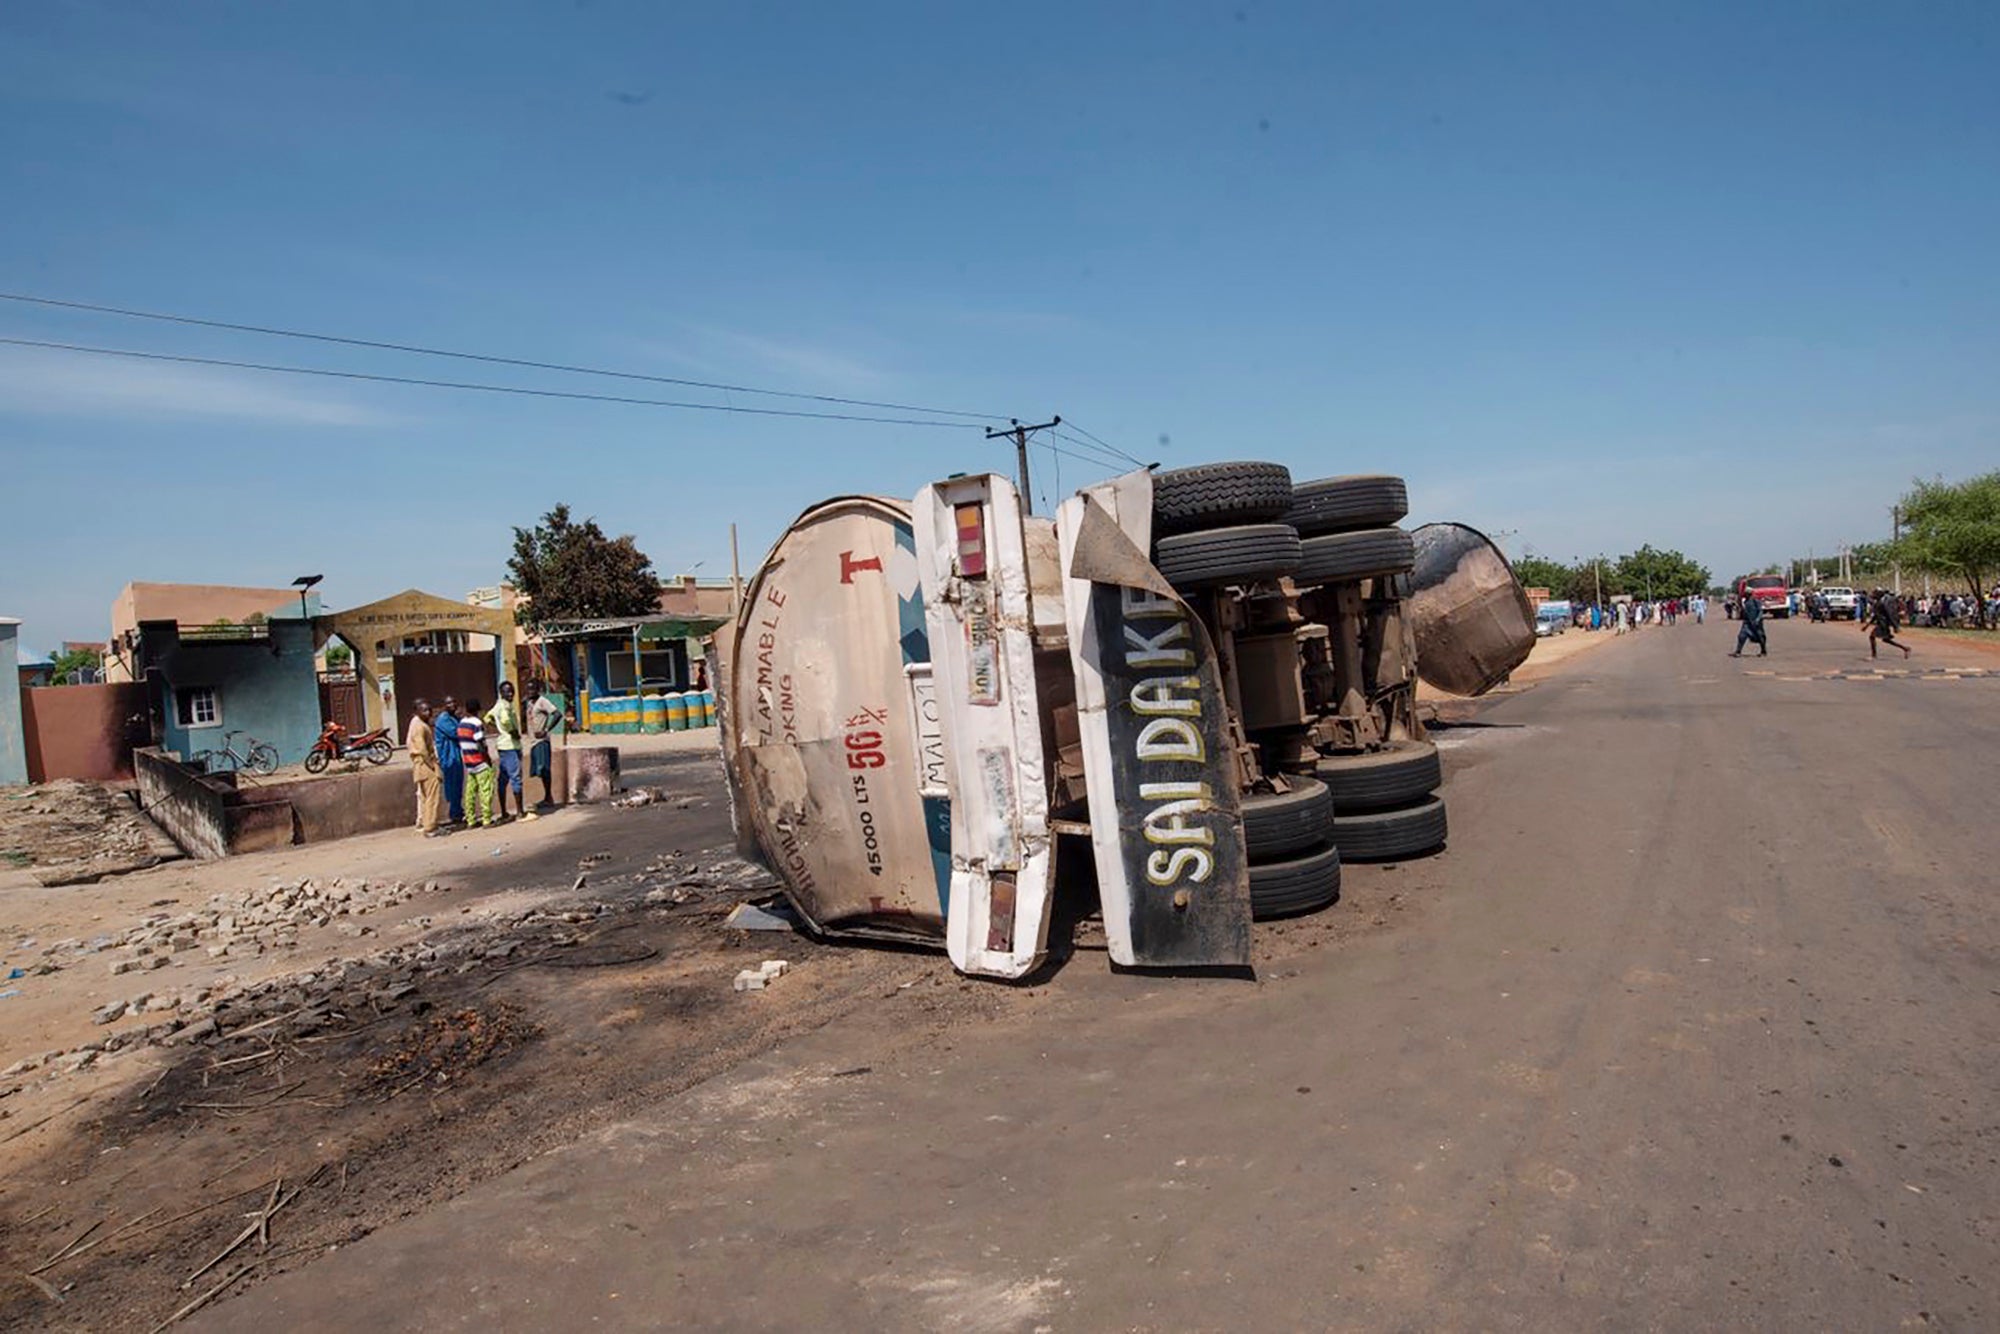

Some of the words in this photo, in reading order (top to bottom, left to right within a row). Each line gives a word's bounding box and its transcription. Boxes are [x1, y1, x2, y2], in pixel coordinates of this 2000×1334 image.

[839, 550, 883, 584] T
[853, 775, 869, 804] LTS
[860, 811, 883, 876] 45000
